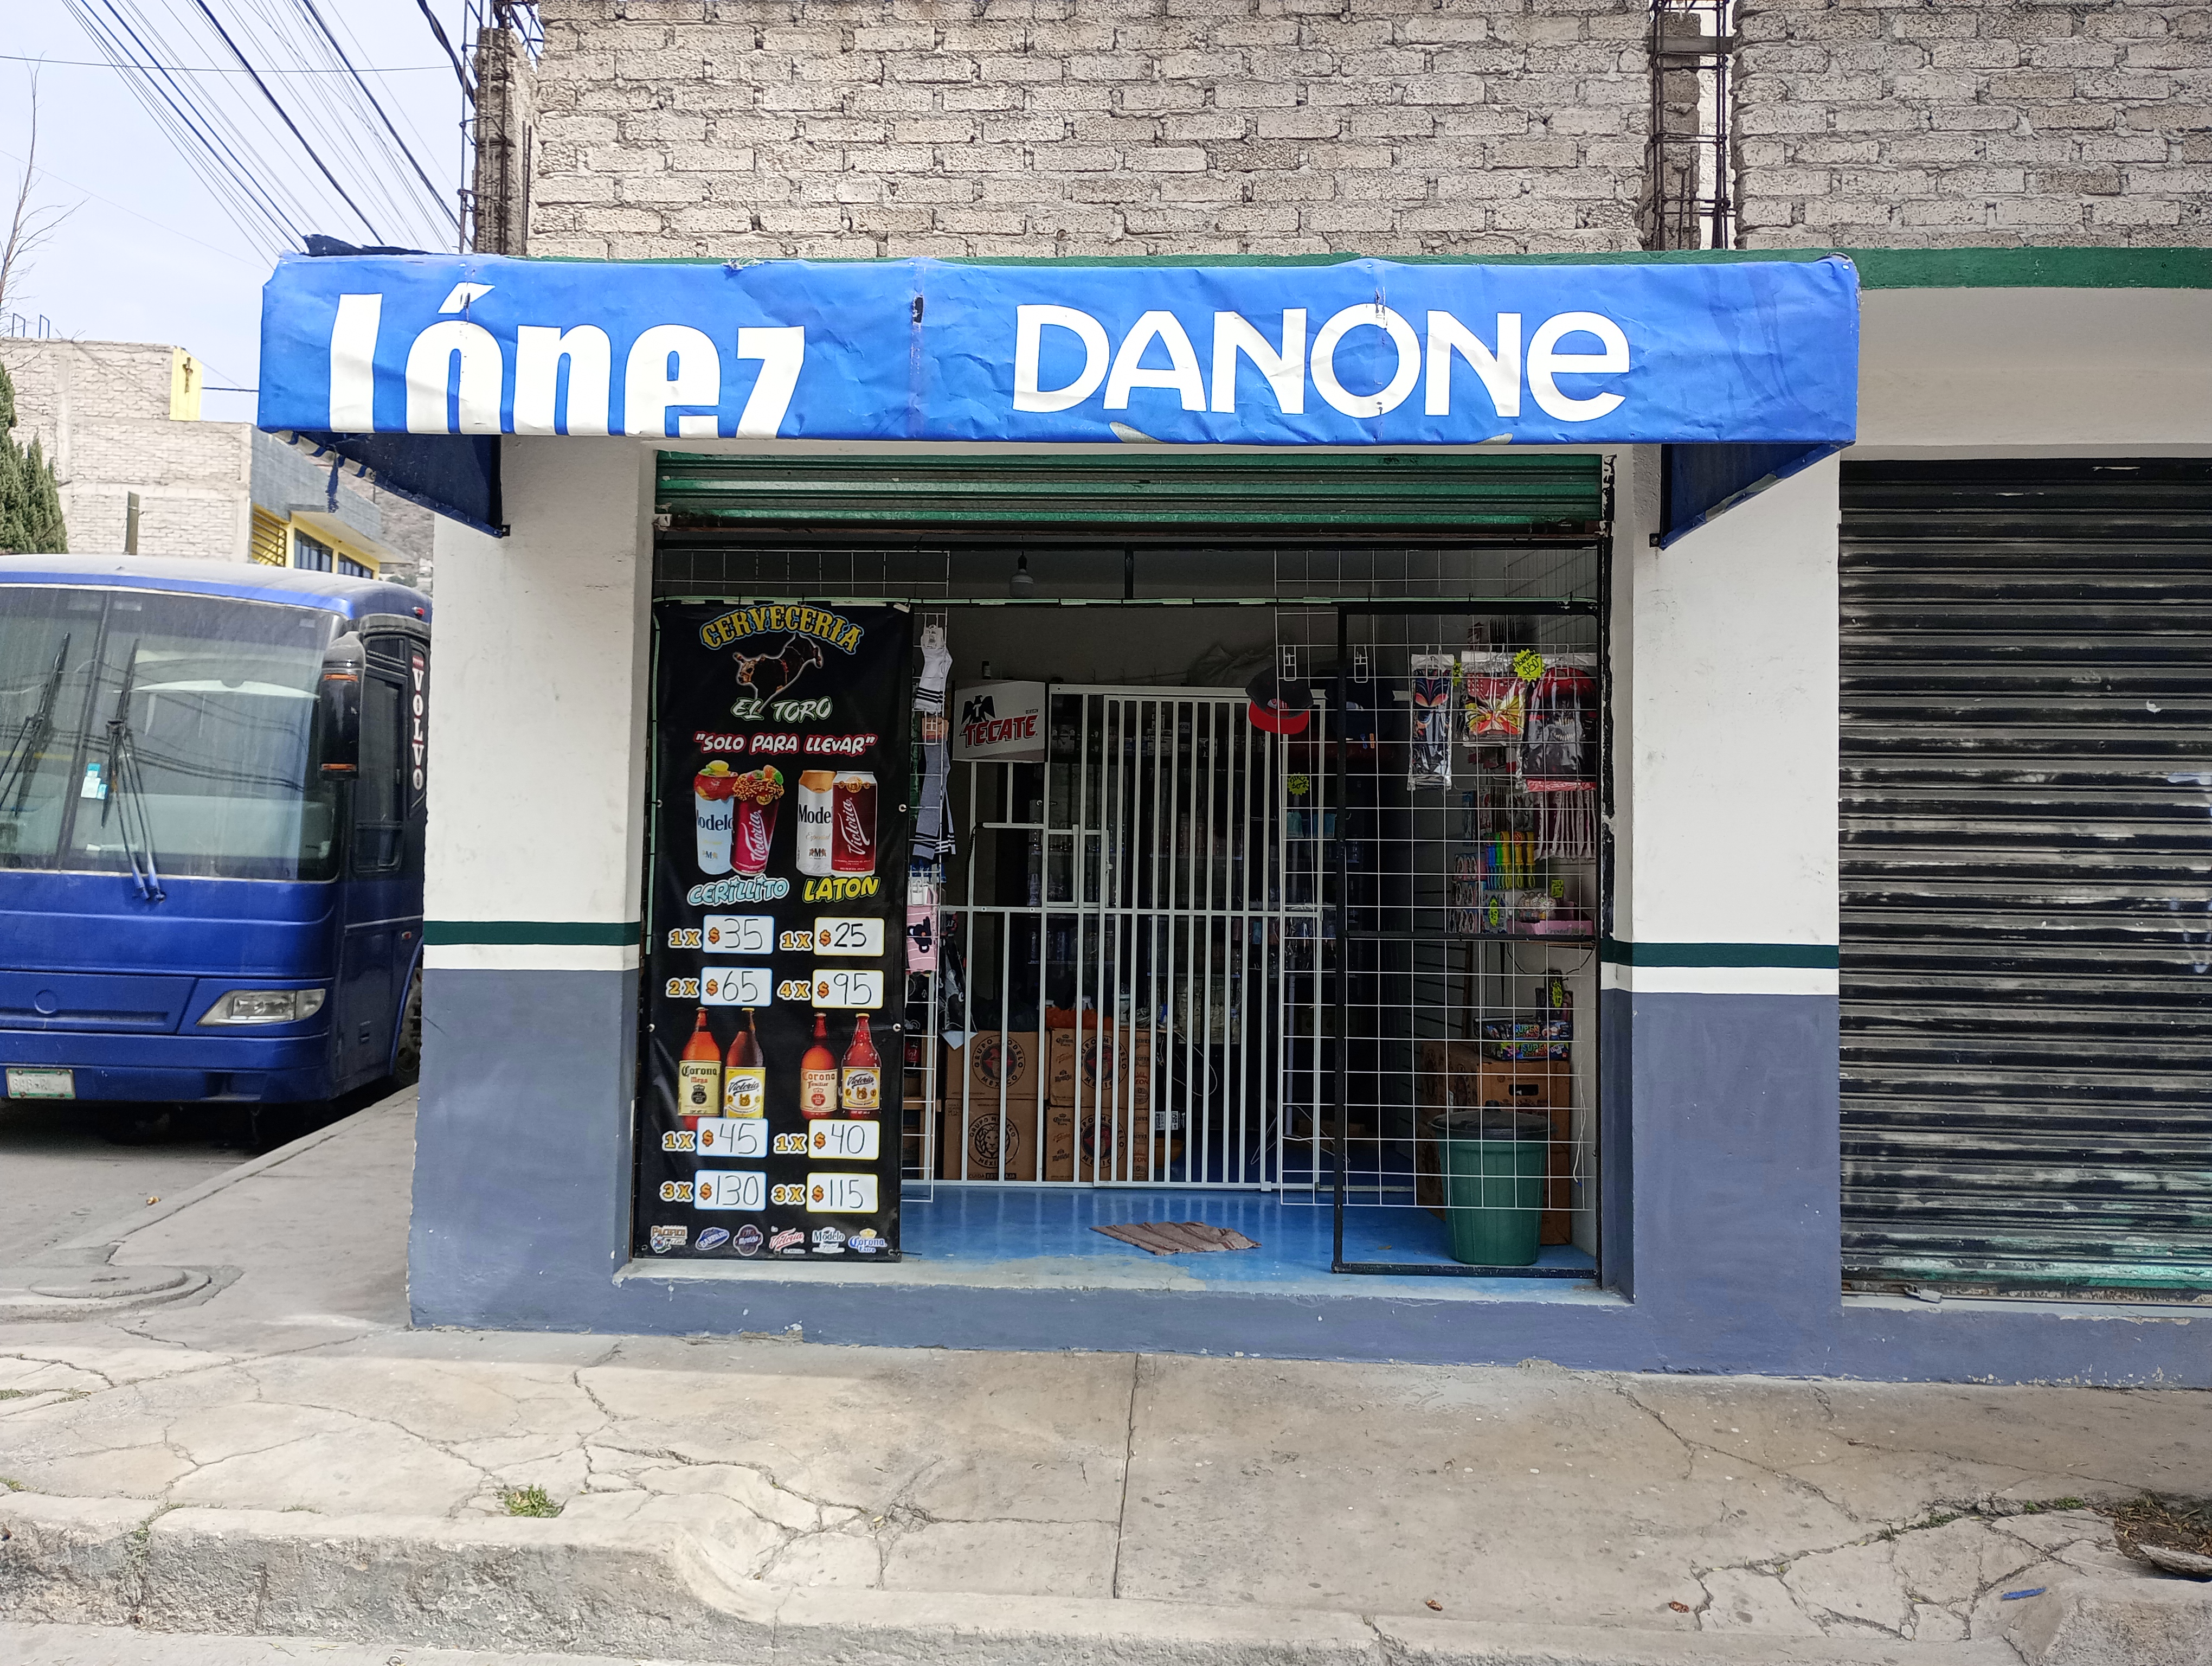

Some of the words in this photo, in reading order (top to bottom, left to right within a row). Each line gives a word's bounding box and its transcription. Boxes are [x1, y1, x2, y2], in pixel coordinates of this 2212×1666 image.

[701, 605, 863, 652] CERVECERIA
[732, 699, 763, 720] EL
[773, 697, 831, 721] TORO
[412, 667, 425, 791] VOLVO
[960, 714, 1038, 748] TECATE
[751, 734, 798, 753] PARA
[741, 810, 769, 862] Victoria
[838, 798, 870, 855] Victoria
[804, 877, 879, 901] LATON
[974, 1039, 993, 1068] GRUPO
[999, 1039, 1024, 1068] ODELO
[681, 1066, 717, 1078] Corona
[802, 1071, 835, 1081] Corona
[847, 1073, 874, 1090] Victoria
[981, 1075, 1018, 1087] MEXCO
[728, 1078, 760, 1097] Victoria
[969, 1117, 988, 1137] GRUPO
[770, 1228, 803, 1249] Victoria
[814, 1231, 844, 1241] Modelo
[849, 1236, 884, 1247] Corona
